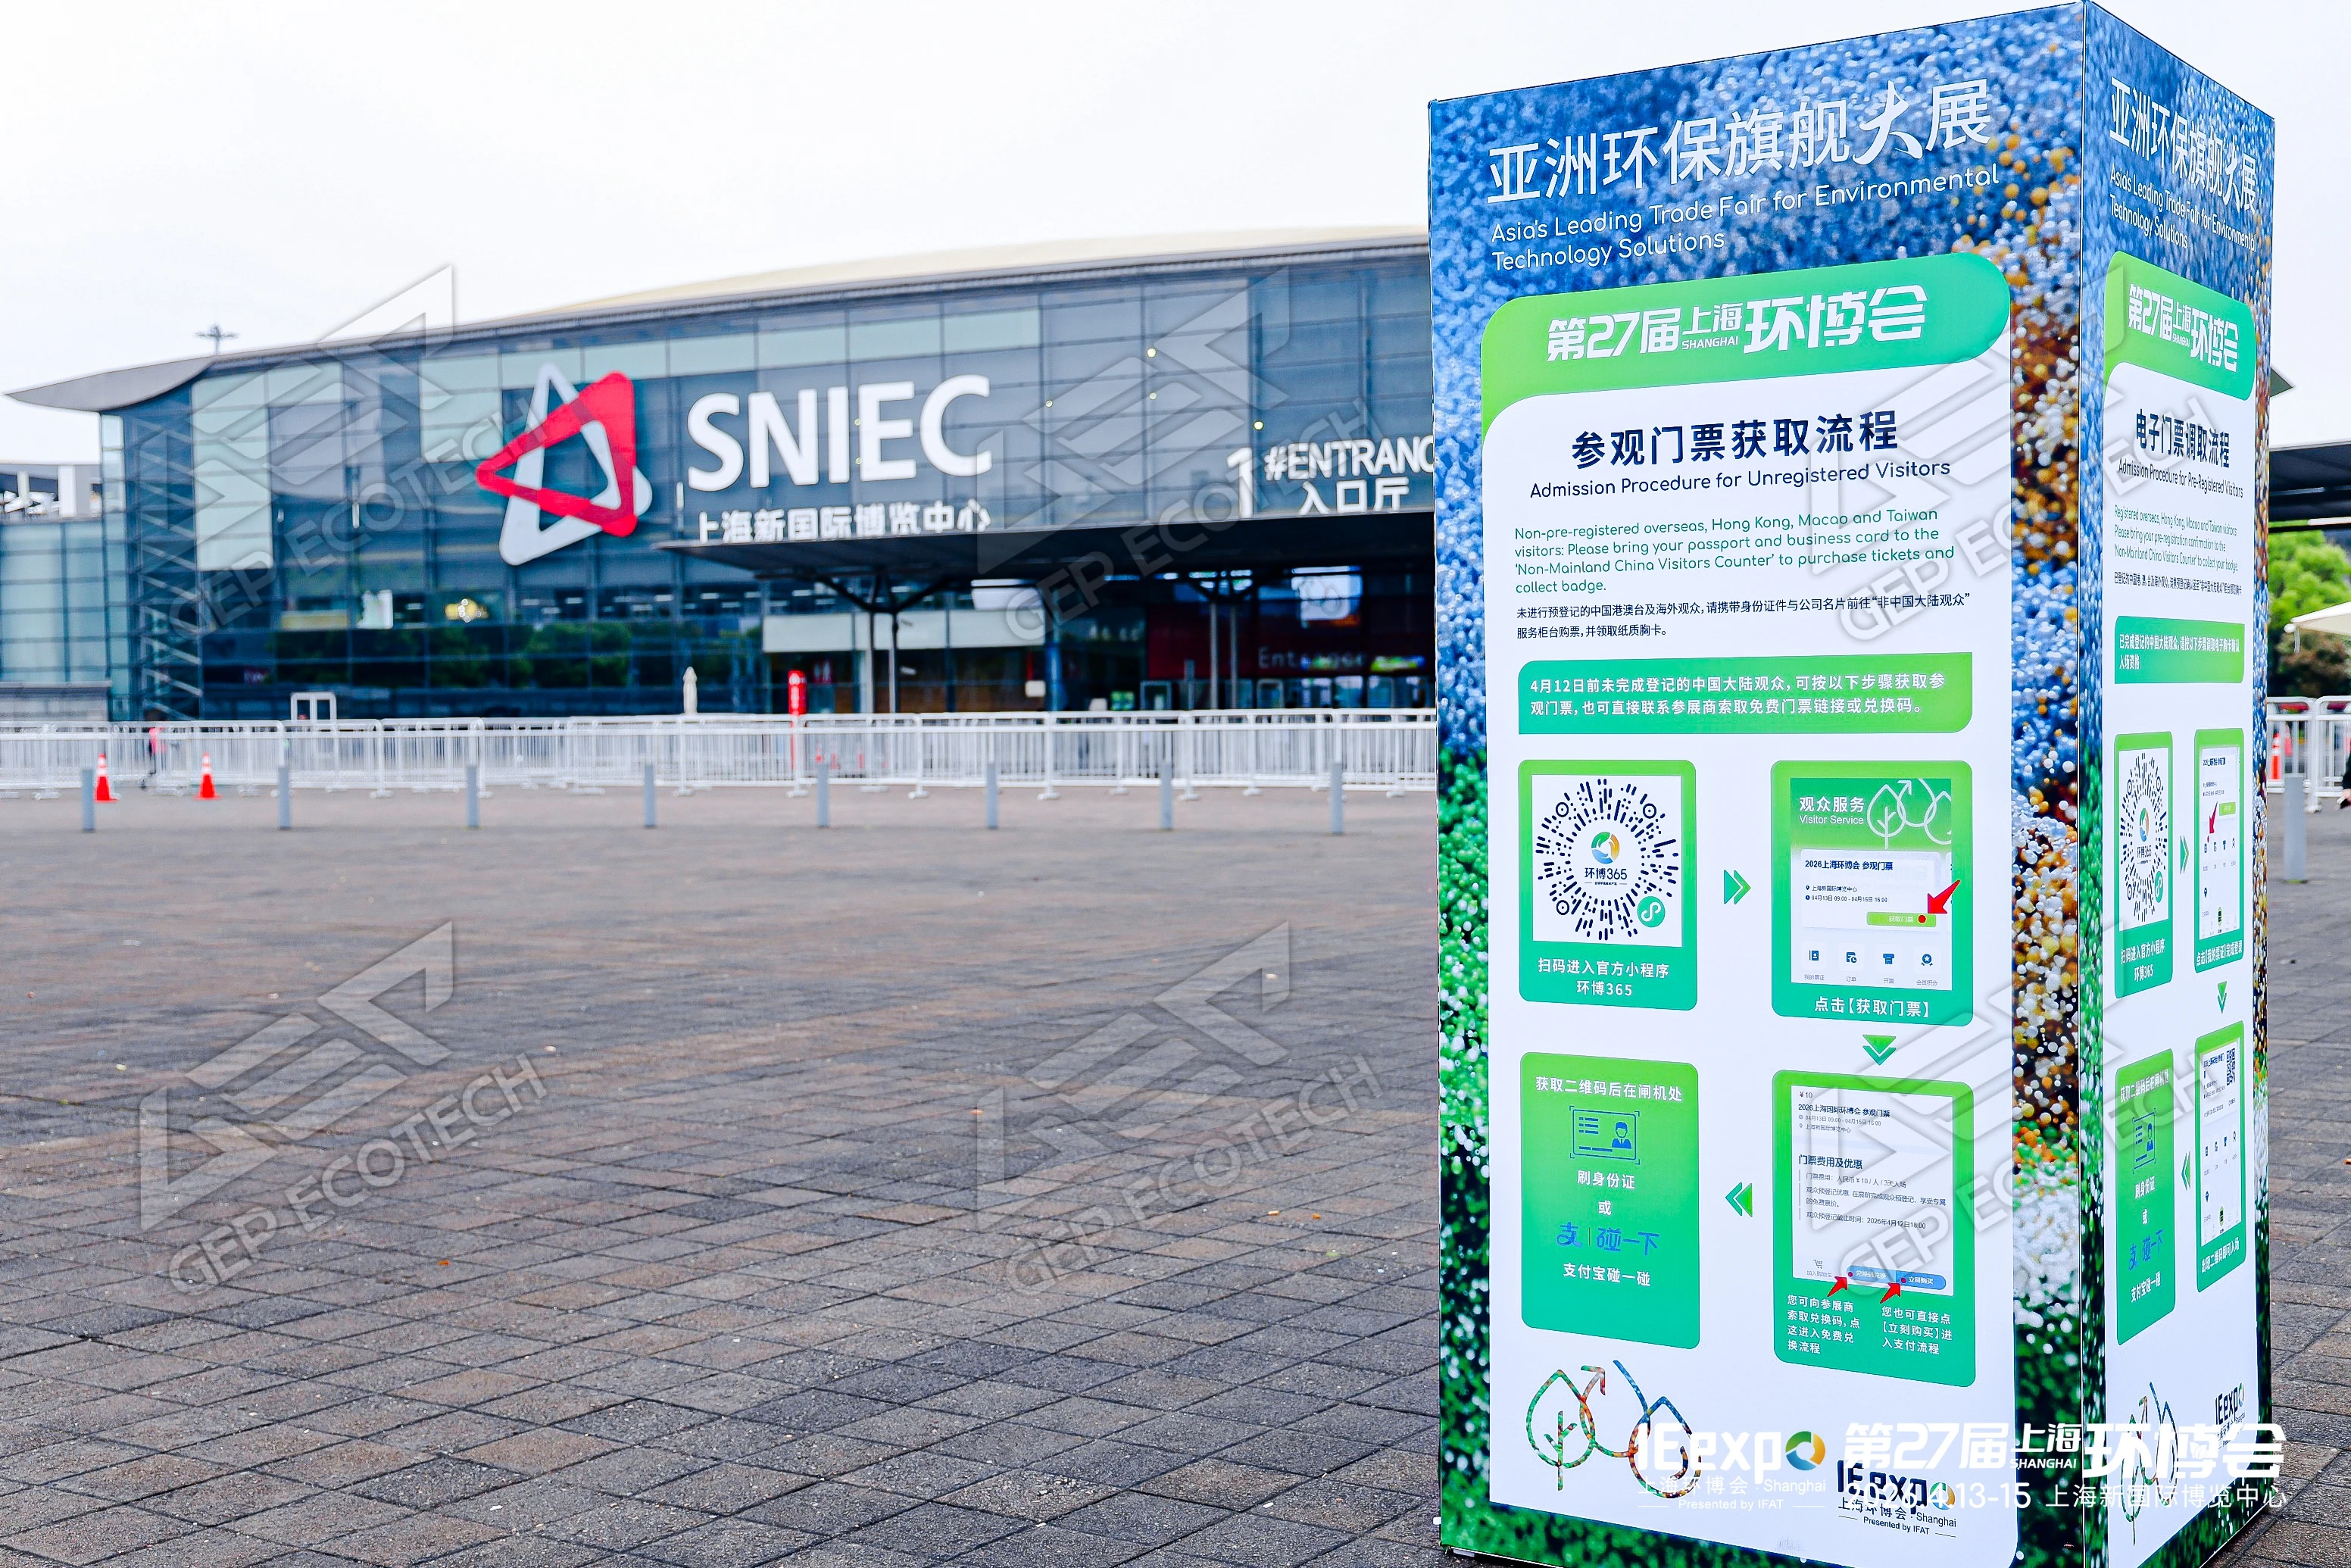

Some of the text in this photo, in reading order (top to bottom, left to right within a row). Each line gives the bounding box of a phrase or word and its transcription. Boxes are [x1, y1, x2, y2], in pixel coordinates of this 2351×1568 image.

[1486, 78, 1992, 204] 亚洲环保旗舰大展
[2109, 77, 2256, 214] 亚洲环保旗舰大展
[1491, 164, 1999, 242] Asia's Leading Trade Fair for Environmental
[2110, 163, 2256, 251] Asia's Leading Trade Fair for Environmental
[2110, 194, 2188, 249] Technology Solutions
[1491, 230, 1725, 272] Technology Solutions
[1547, 284, 1928, 362] 第27届上海环博会
[2128, 283, 2239, 373] 第27届上海环博会
[1681, 335, 1739, 351] SHANGHAI
[687, 374, 992, 492] SNIEC
[1572, 410, 1897, 470] 参观门票获取流程
[2136, 408, 2230, 468] 电子门票调取流程
[1264, 436, 1433, 480] #ENTRANC
[1530, 460, 1950, 498] Admission Procedure for Unregistered Visitors
[2118, 458, 2243, 498] Admission Procedure for Pre-Registered Visitors
[1298, 477, 1410, 516] 入口厅
[698, 497, 991, 543] 上海新国际博览中心
[1515, 508, 1938, 542] Non-pre-registered overseas, Hong Kong, Macao and Taiwan
[2114, 504, 2139, 521] Registered
[2161, 512, 2173, 528] Hong
[2186, 517, 2200, 529] Macao
[2201, 518, 2209, 531] and
[1515, 526, 1939, 558] visitors: Please bring your passport and business card to the
[2114, 524, 2129, 538] Please
[2130, 527, 2143, 543] bring
[2143, 531, 2153, 544] your
[1614, 555, 1654, 573] China
[1658, 552, 1710, 570] Visitors
[1778, 551, 1794, 565] to
[1797, 549, 1867, 567] purchase
[1871, 547, 1921, 562] tickets
[1925, 545, 1954, 561] and
[2148, 548, 2162, 562] China
[2162, 550, 2179, 564] Visitors
[1516, 578, 1606, 595] collect badge.
[1799, 796, 1865, 813] 观众服务
[1800, 814, 1864, 824] Visitor Service
[2137, 845, 2152, 858] 环博365
[1585, 867, 1628, 880] 环博365
[1805, 860, 1894, 871] 2026上海环博会 参观门票
[1538, 957, 1670, 979] 扫码进入官方小程序
[2134, 964, 2154, 982] 环博365
[1576, 980, 1633, 997] 环博365
[1814, 996, 1929, 1018] 点击【获取门票】
[1535, 1076, 1682, 1102] 获取二维码后在闸机处
[1862, 1108, 1890, 1118] 参观门票
[1798, 1154, 1863, 1170] 门票费用及优惠
[1577, 1170, 1635, 1189] 刷身份证
[2135, 1176, 2155, 1199] 刷身份证
[1598, 1200, 1612, 1216] 或
[1556, 1222, 1660, 1256] 支 碰一下
[1563, 1262, 1650, 1287] 支付宝碰一碰
[1787, 1295, 1853, 1313] 您可向参展商
[1882, 1306, 1951, 1325] 您也可直接点
[1787, 1325, 1854, 1344] 这进入免费兑
[1883, 1321, 1953, 1341] 【立刻购买】进
[1787, 1340, 1821, 1354] 换流程
[1882, 1337, 1940, 1354] 入支付流程
[1863, 1516, 1930, 1535] Presented by IFAT
[1916, 1510, 1957, 1529] Shanghai
